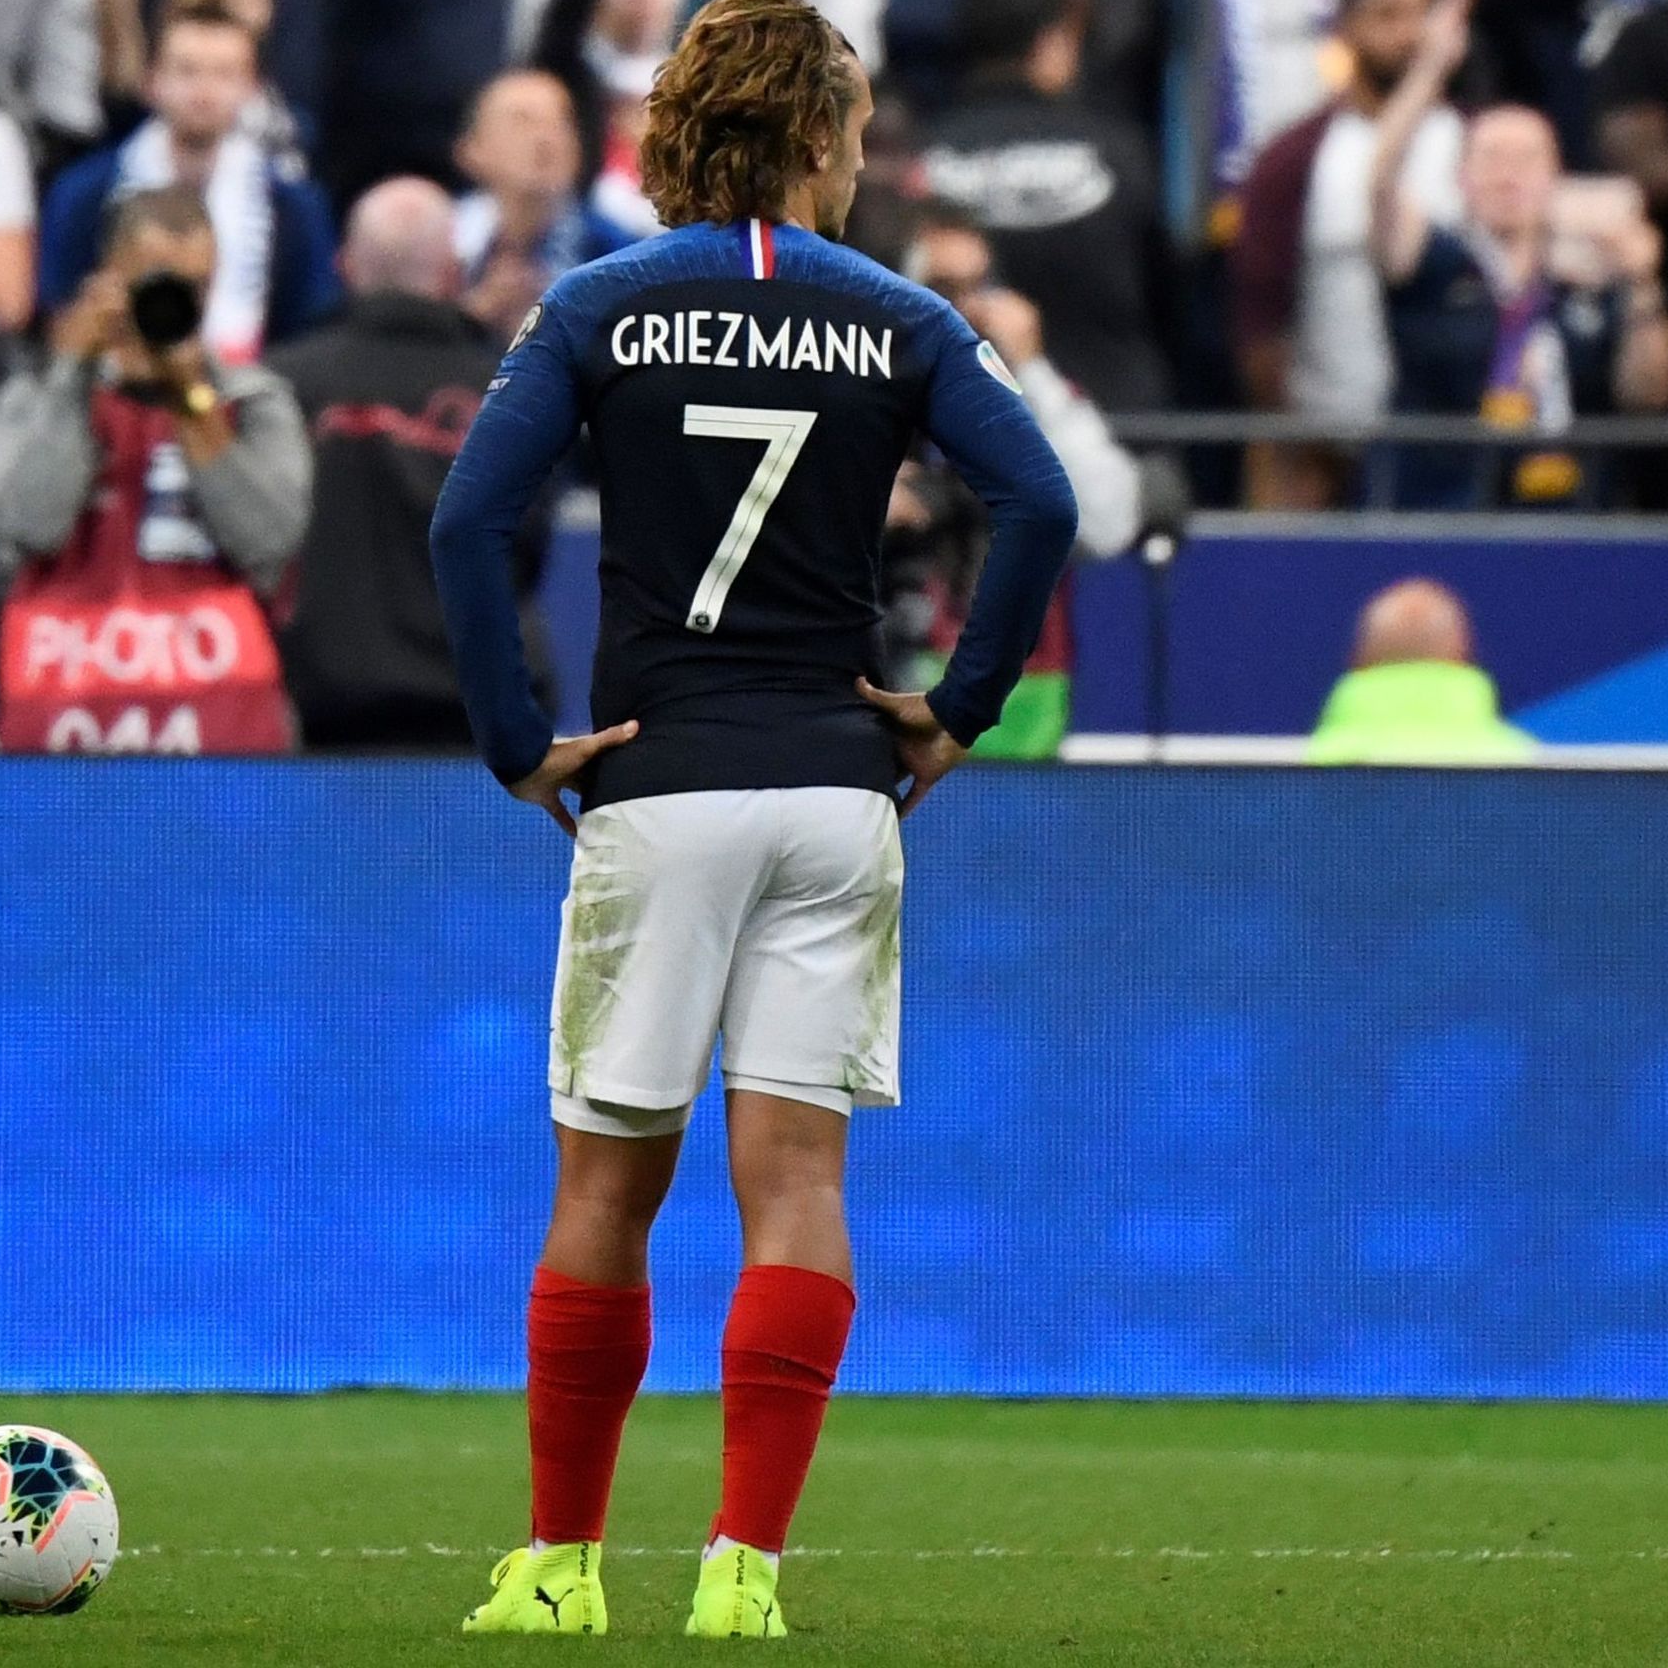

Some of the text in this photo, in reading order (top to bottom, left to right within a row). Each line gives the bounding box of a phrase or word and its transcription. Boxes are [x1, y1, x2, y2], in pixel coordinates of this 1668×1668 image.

[611, 310, 892, 379] GRIEZMANN
[683, 404, 818, 633] 7
[24, 608, 238, 690] PHOTO
